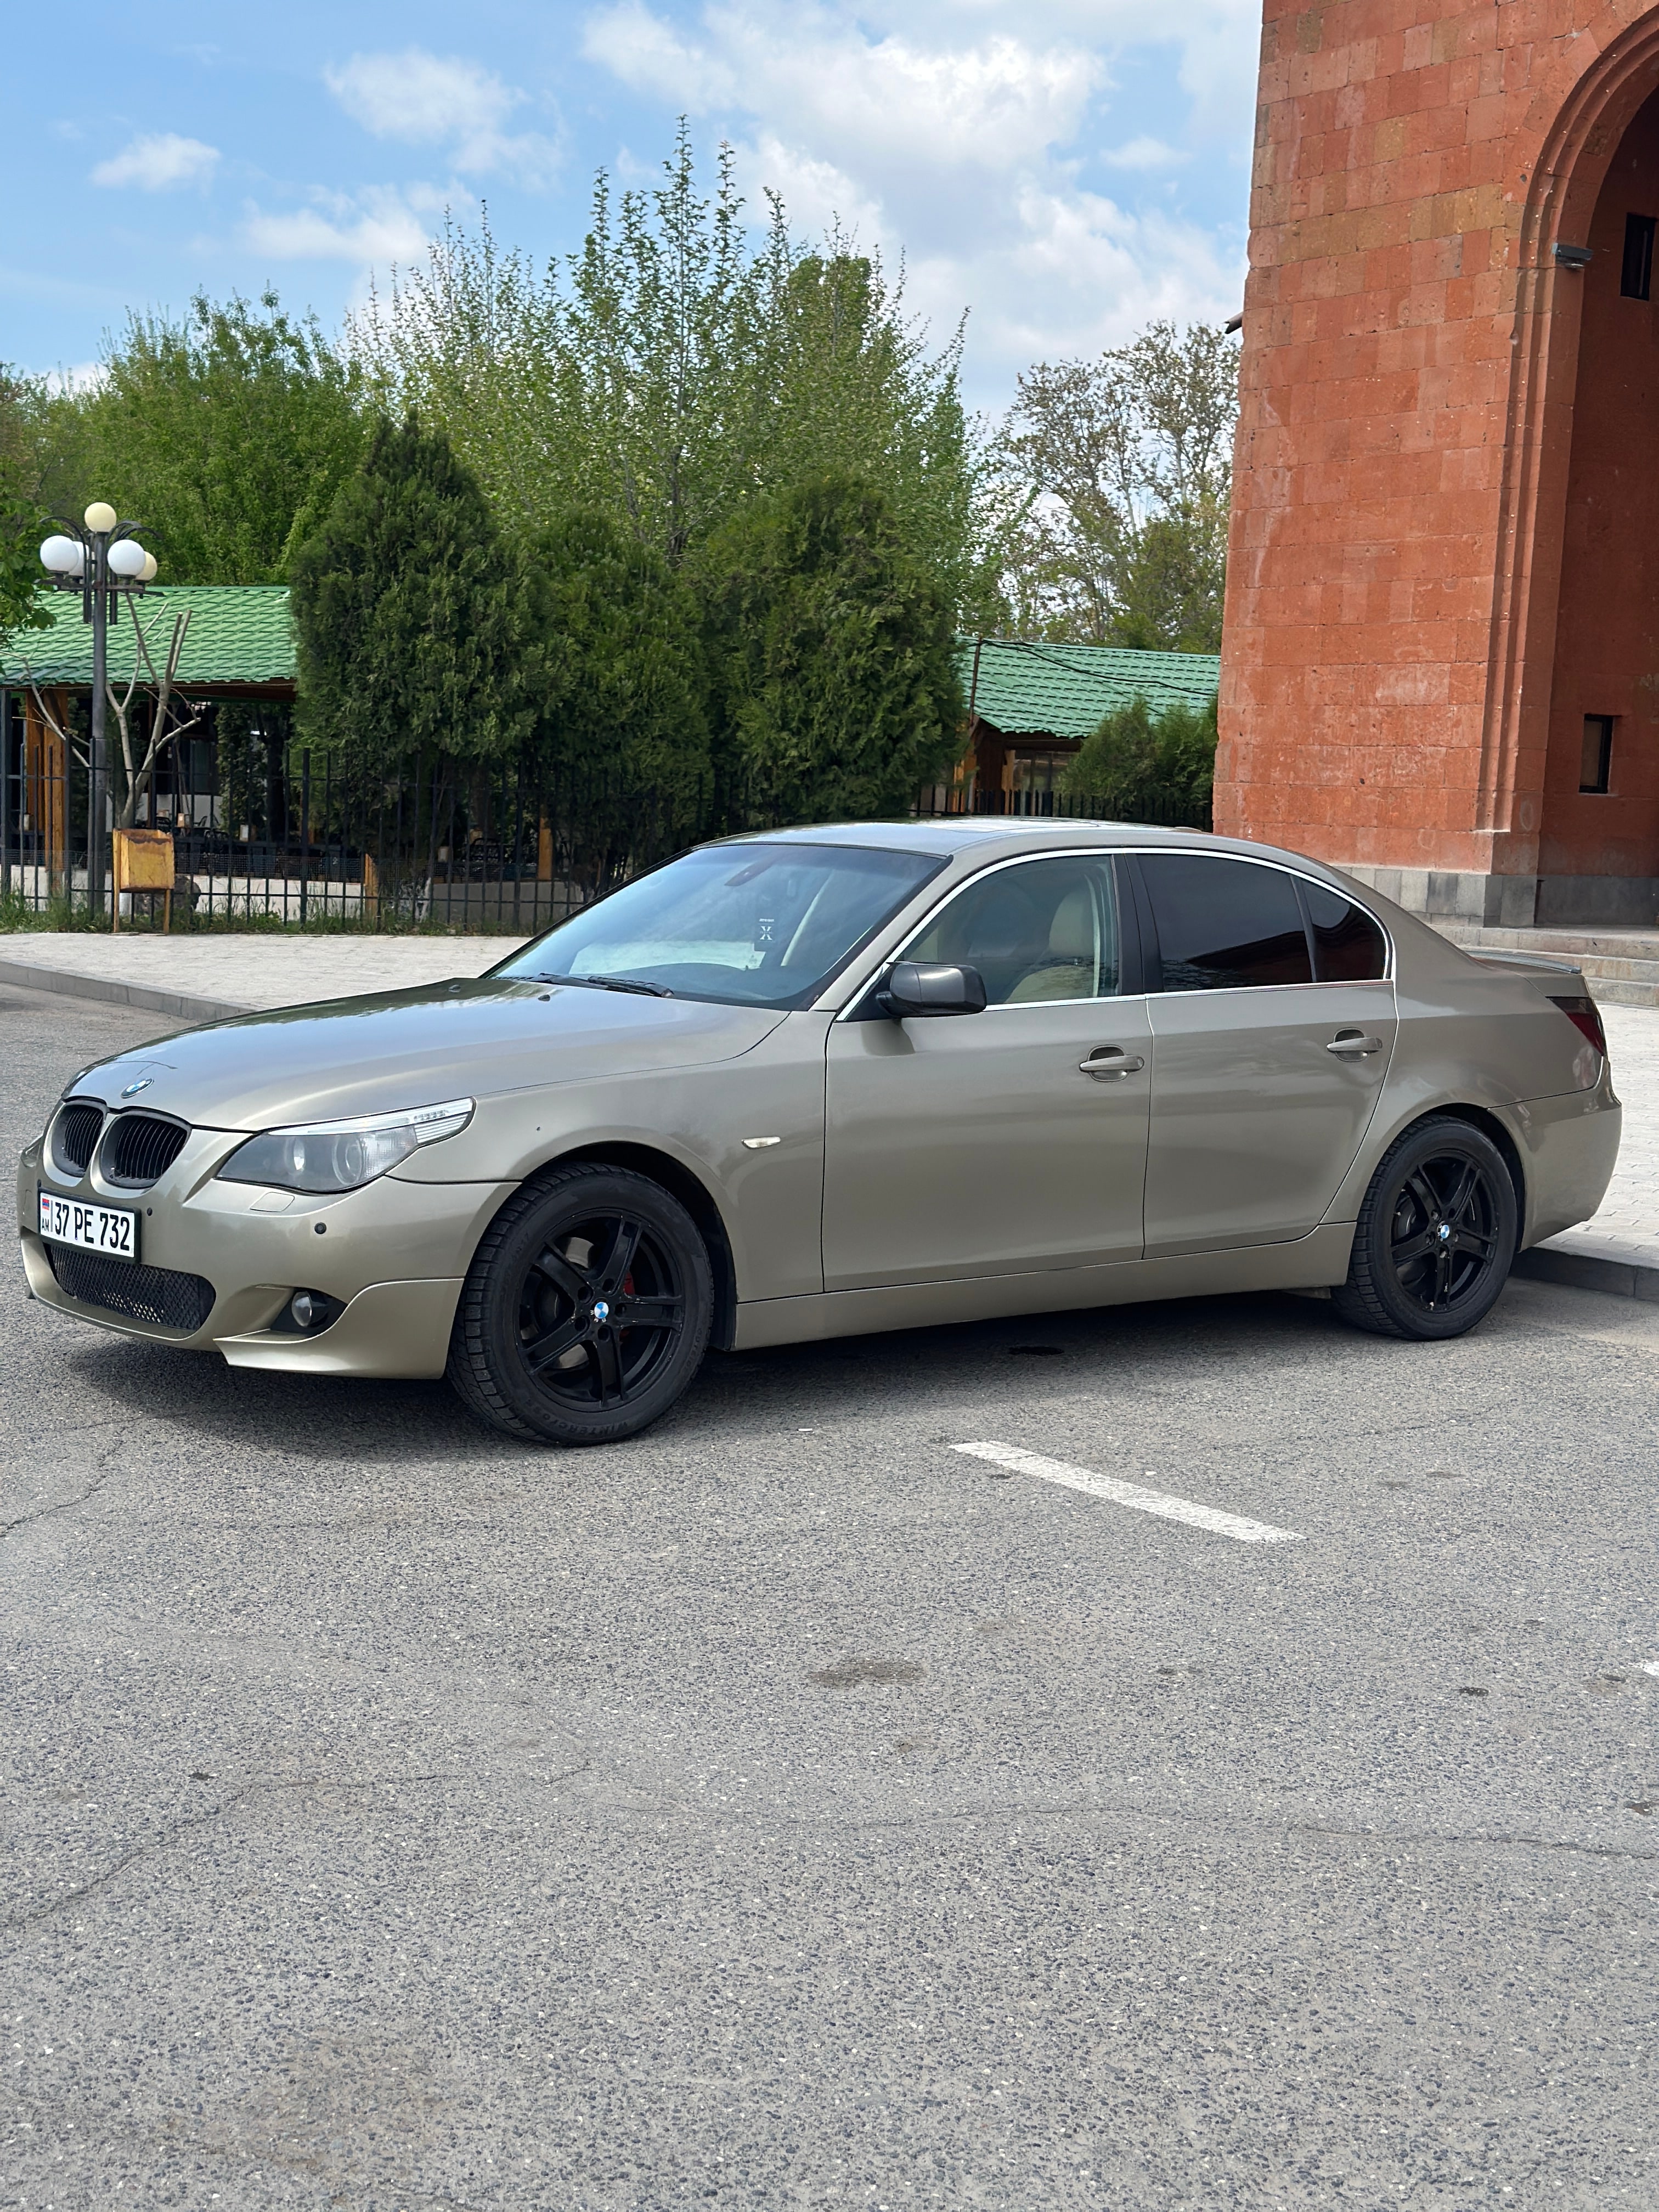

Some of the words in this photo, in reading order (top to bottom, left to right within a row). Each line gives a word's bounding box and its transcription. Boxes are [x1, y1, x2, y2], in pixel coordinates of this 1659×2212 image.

[42, 1217, 49, 1232] AM
[55, 1202, 69, 1237] 37
[74, 1207, 94, 1244] PE
[100, 1212, 129, 1251] 732
